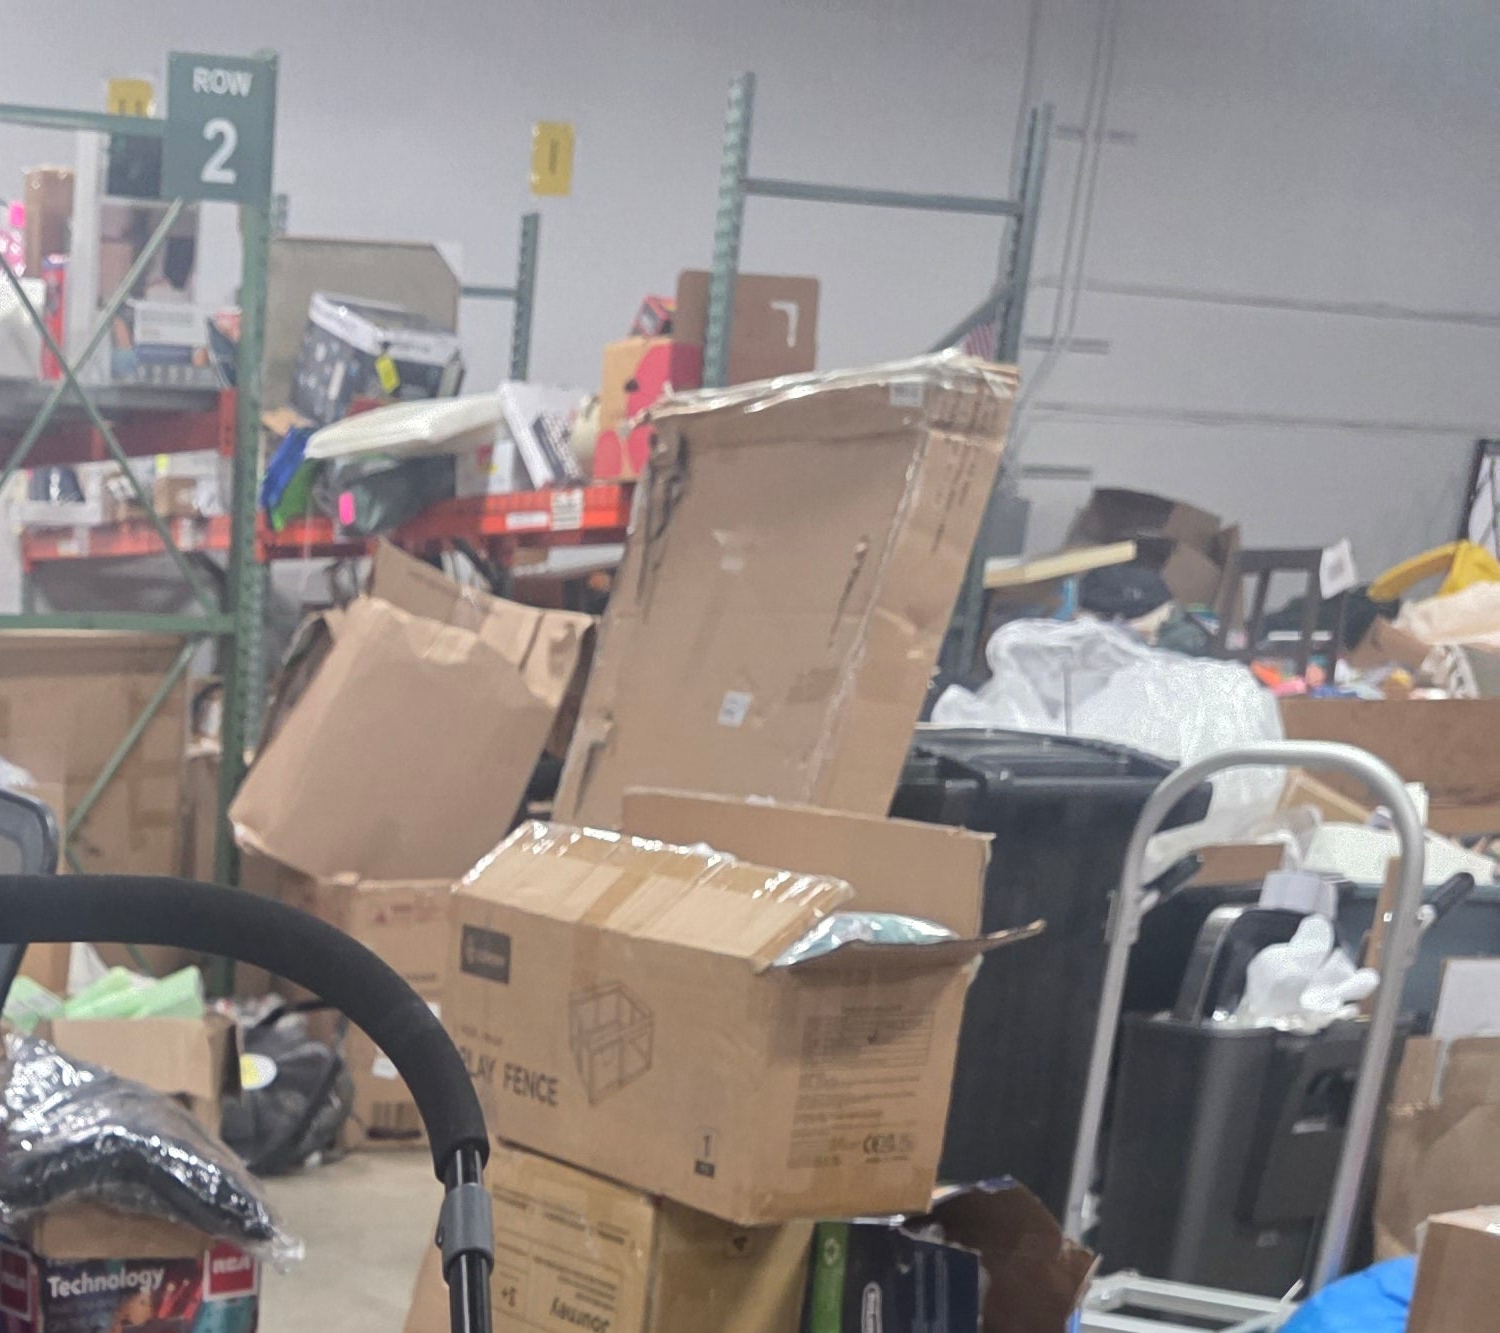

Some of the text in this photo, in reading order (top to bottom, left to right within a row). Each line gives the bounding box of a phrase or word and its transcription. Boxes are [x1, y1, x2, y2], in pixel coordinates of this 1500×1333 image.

[193, 66, 253, 98] ROW
[200, 117, 238, 185] 2
[503, 1062, 559, 1108] FENCE
[47, 1267, 166, 1299] Technology
